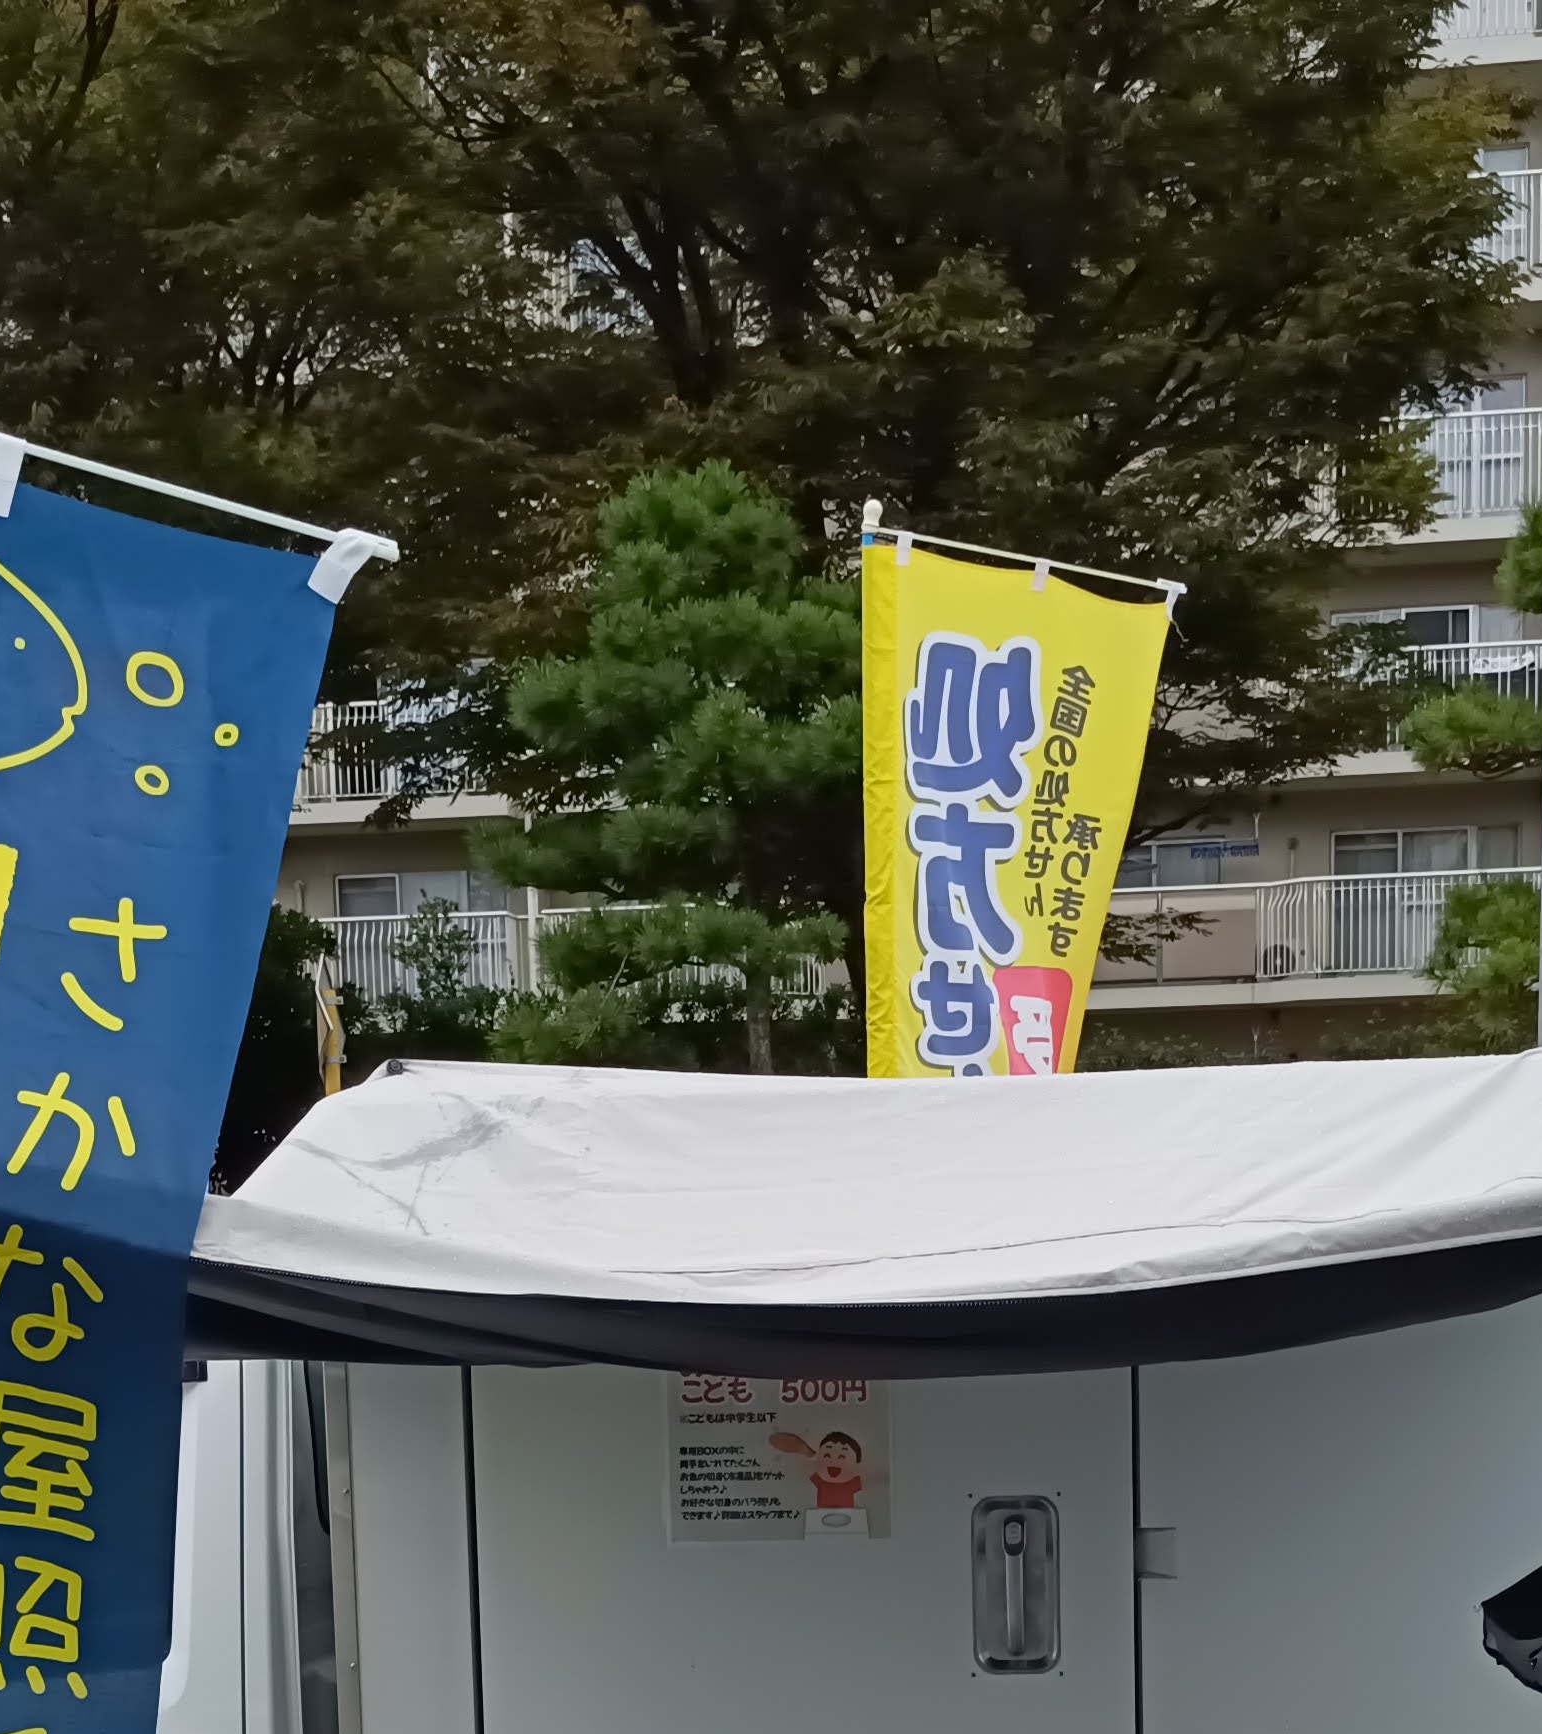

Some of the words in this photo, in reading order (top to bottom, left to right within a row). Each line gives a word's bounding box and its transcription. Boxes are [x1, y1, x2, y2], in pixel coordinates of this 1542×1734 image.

[681, 1377, 752, 1402] こども
[781, 1379, 867, 1402] 500円
